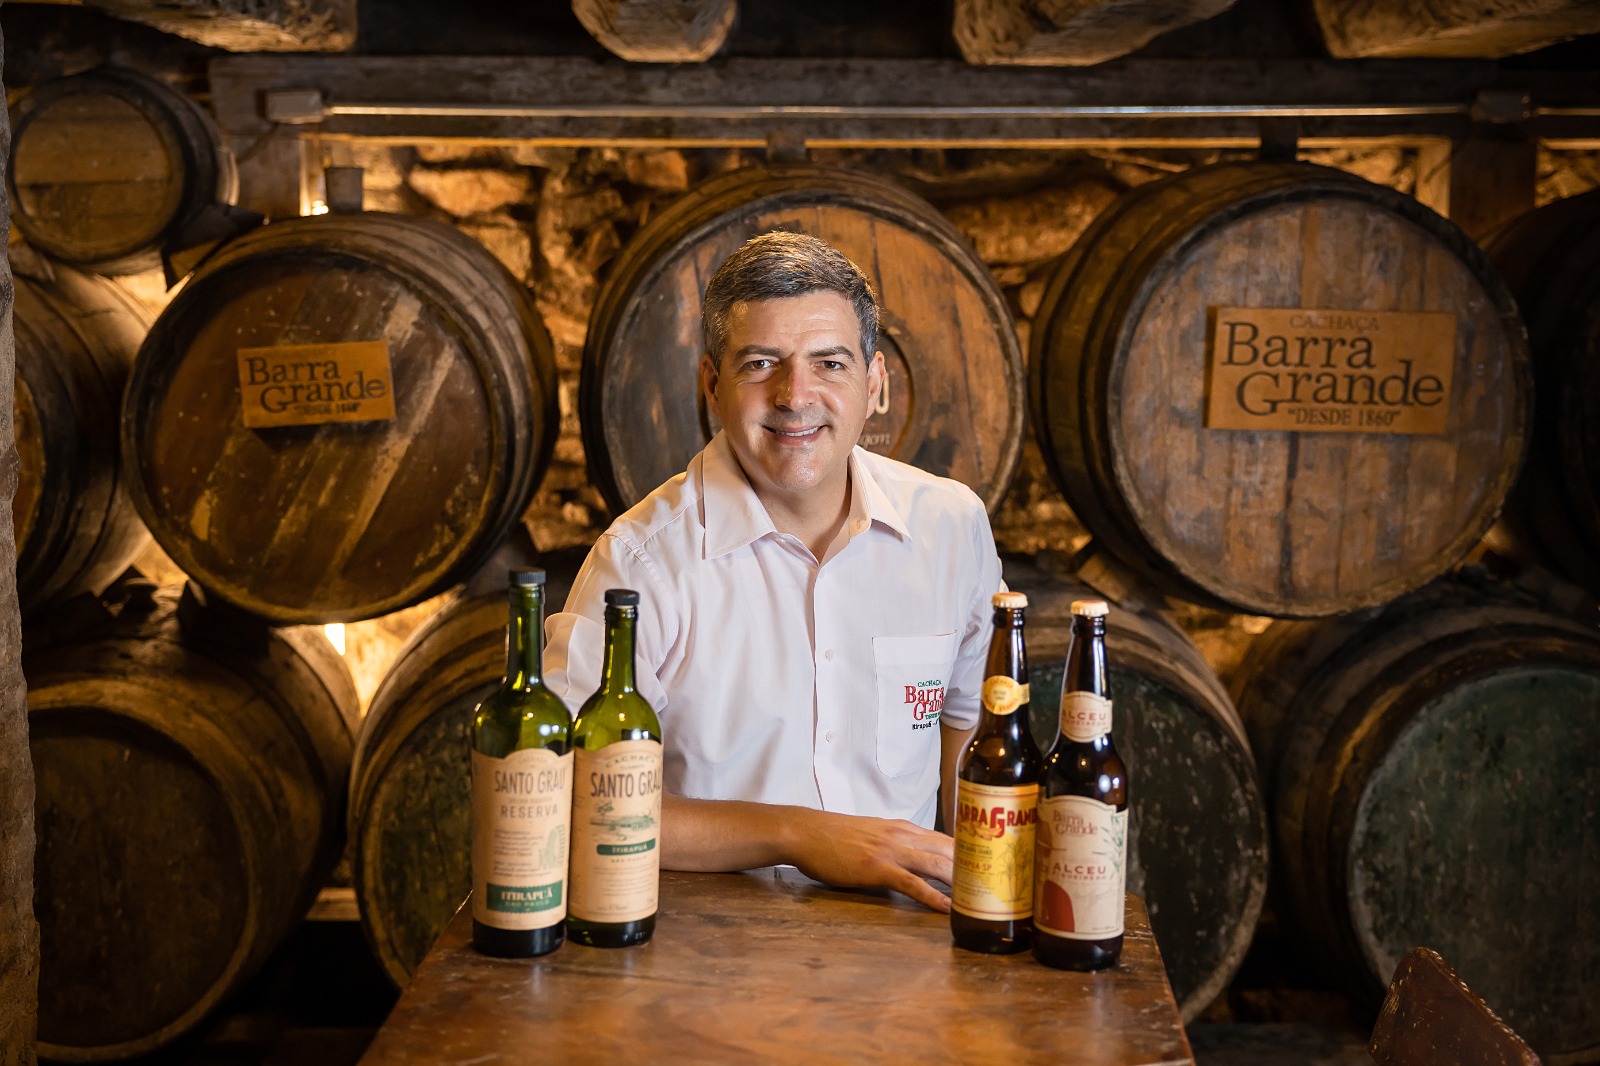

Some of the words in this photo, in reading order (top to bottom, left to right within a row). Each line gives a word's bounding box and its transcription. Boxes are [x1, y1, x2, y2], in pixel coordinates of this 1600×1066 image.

[1289, 315, 1380, 332] CACHAÇA
[1220, 321, 1376, 369] Barra
[246, 356, 341, 386] Barra
[260, 371, 386, 413] Grande
[1236, 359, 1445, 417] Grande
[904, 685, 945, 704] Barra
[1061, 709, 1106, 721] ALCEU
[495, 769, 534, 794] SANTO
[537, 767, 566, 794] GRAU
[591, 770, 634, 798] SANTO
[501, 803, 558, 819] RESERVA
[1053, 861, 1106, 875] ALCEU
